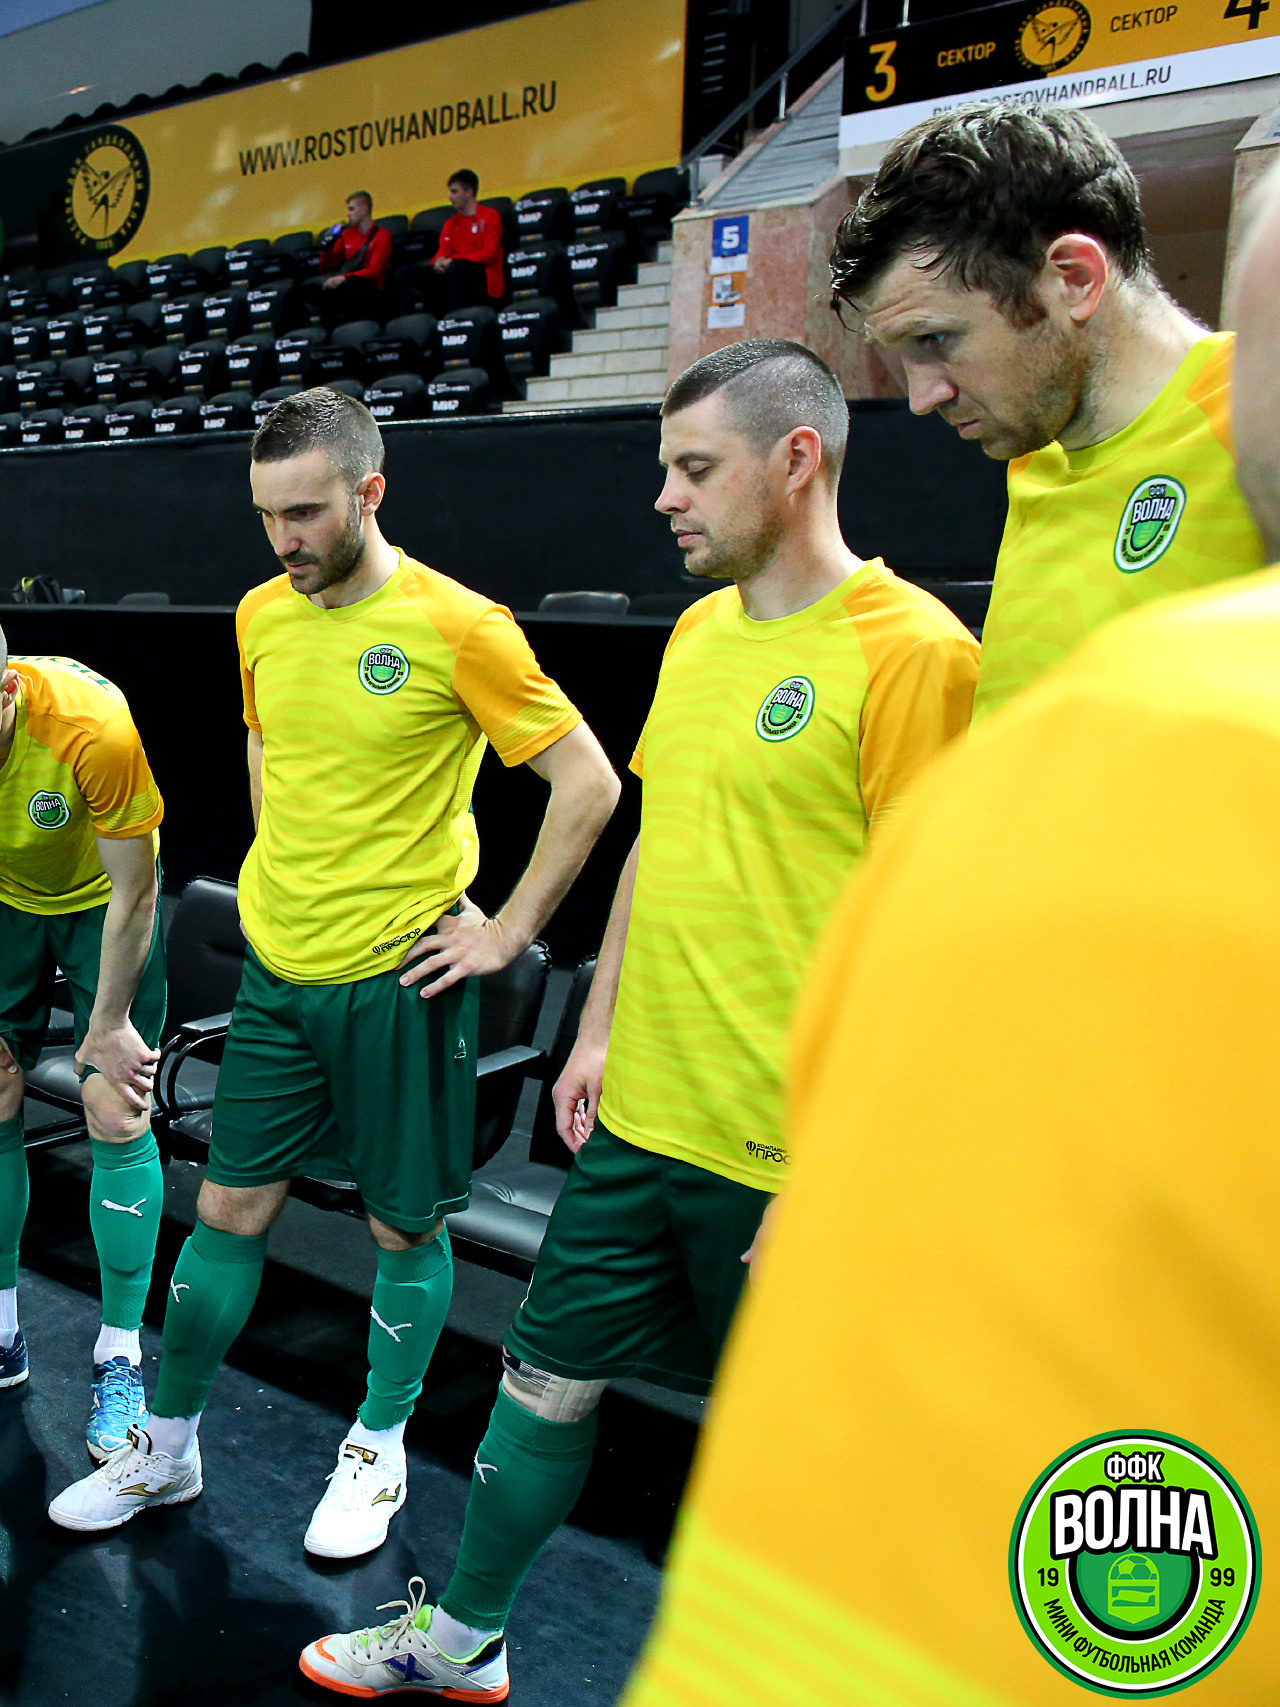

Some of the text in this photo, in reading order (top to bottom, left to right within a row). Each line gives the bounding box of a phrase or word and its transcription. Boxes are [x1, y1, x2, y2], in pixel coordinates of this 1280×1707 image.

[1110, 5, 1178, 33] СЕКТОР
[865, 40, 996, 102] 3 СЕКТОР
[239, 81, 557, 176] WWW.ROSTOVHANDBALL.RU
[721, 225, 740, 249] 5
[1131, 497, 1176, 524] ВОЛНА
[368, 653, 401, 670] ВОЛНА
[771, 688, 807, 711] ВОЛНА
[35, 797, 61, 812] ВОЛНА
